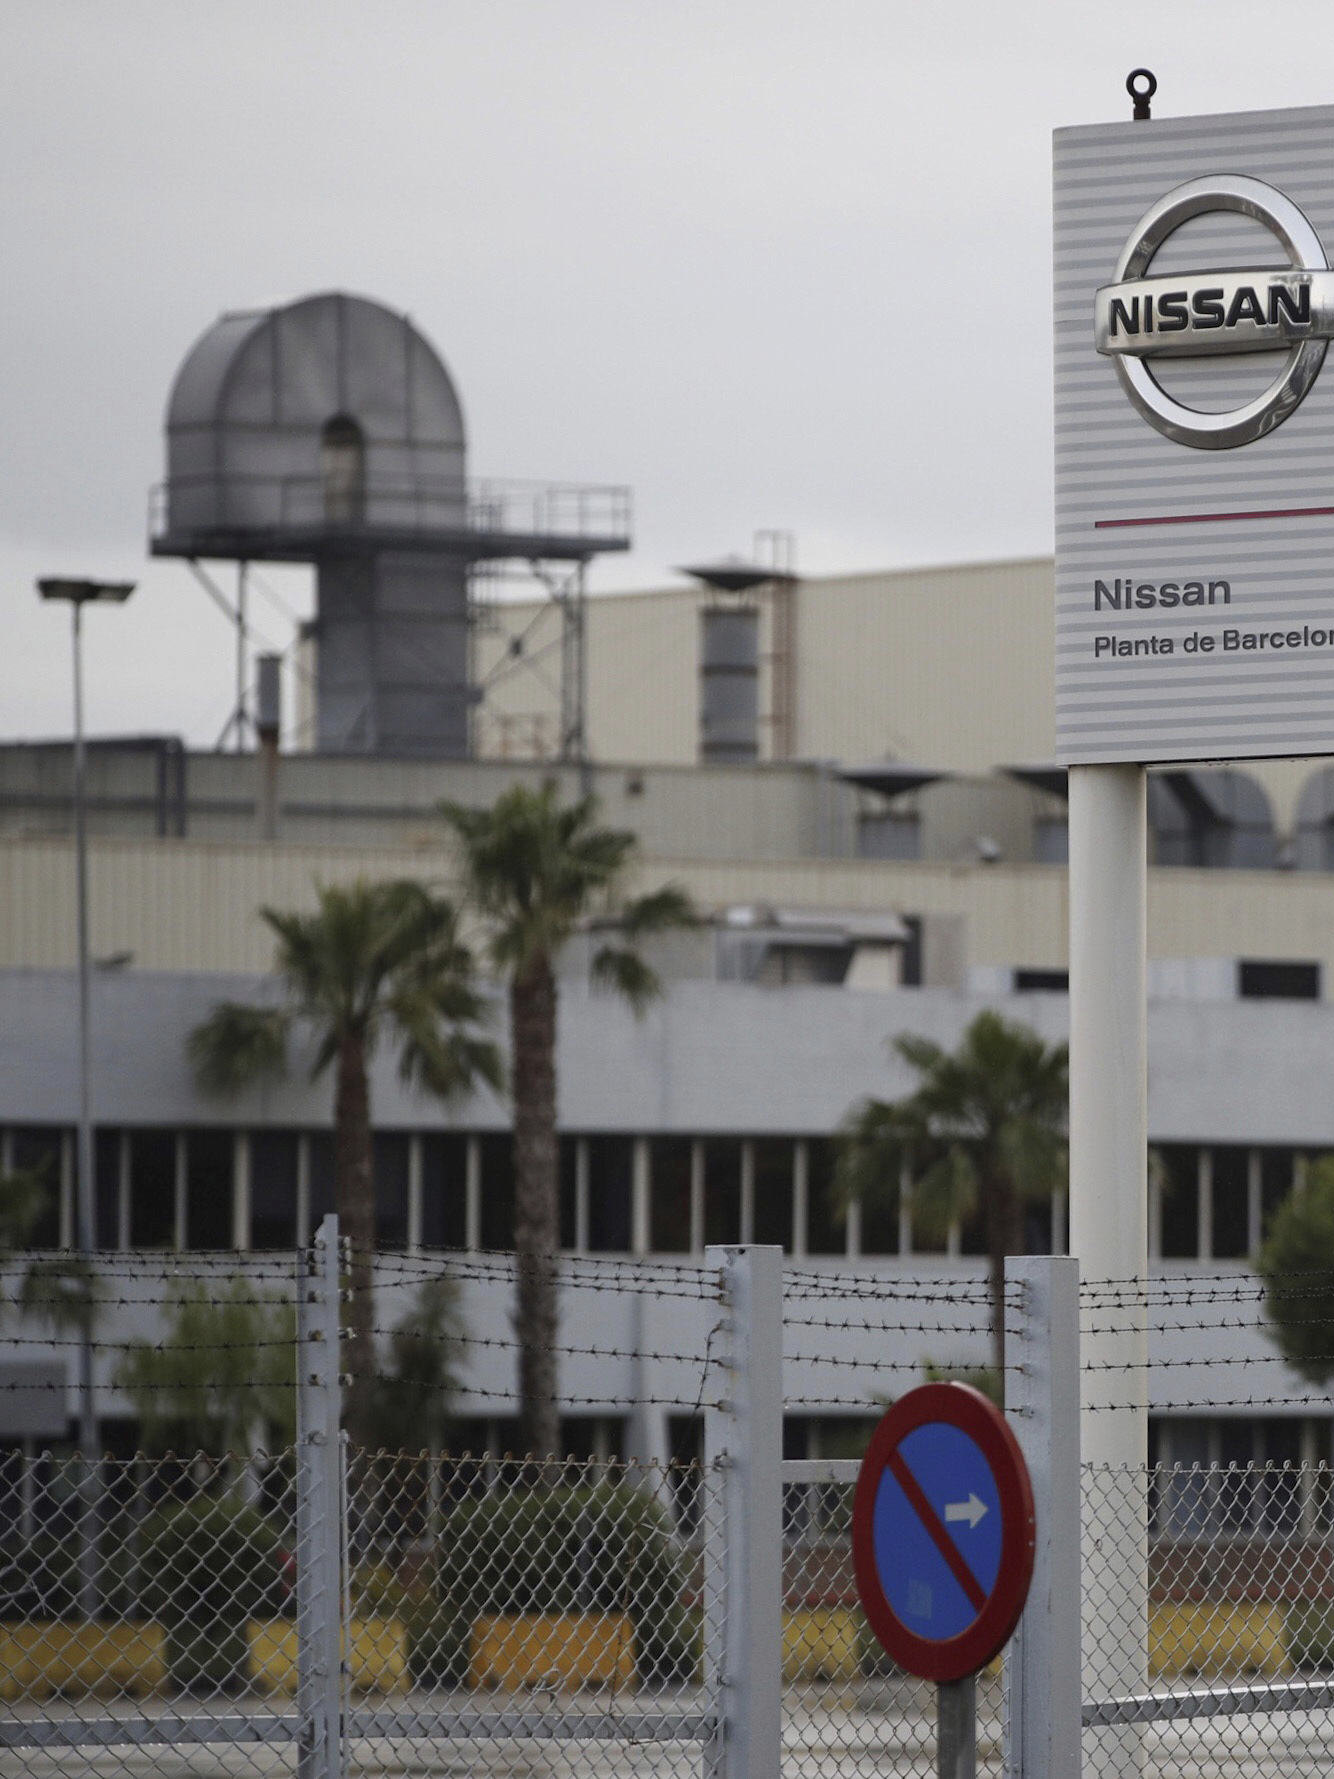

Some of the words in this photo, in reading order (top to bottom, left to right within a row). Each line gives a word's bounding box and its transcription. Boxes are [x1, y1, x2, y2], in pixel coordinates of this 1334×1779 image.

[1109, 284, 1311, 337] NISSAN
[1094, 578, 1231, 611] Nissan
[1094, 635, 1174, 658] Planta
[1183, 631, 1216, 653] de
